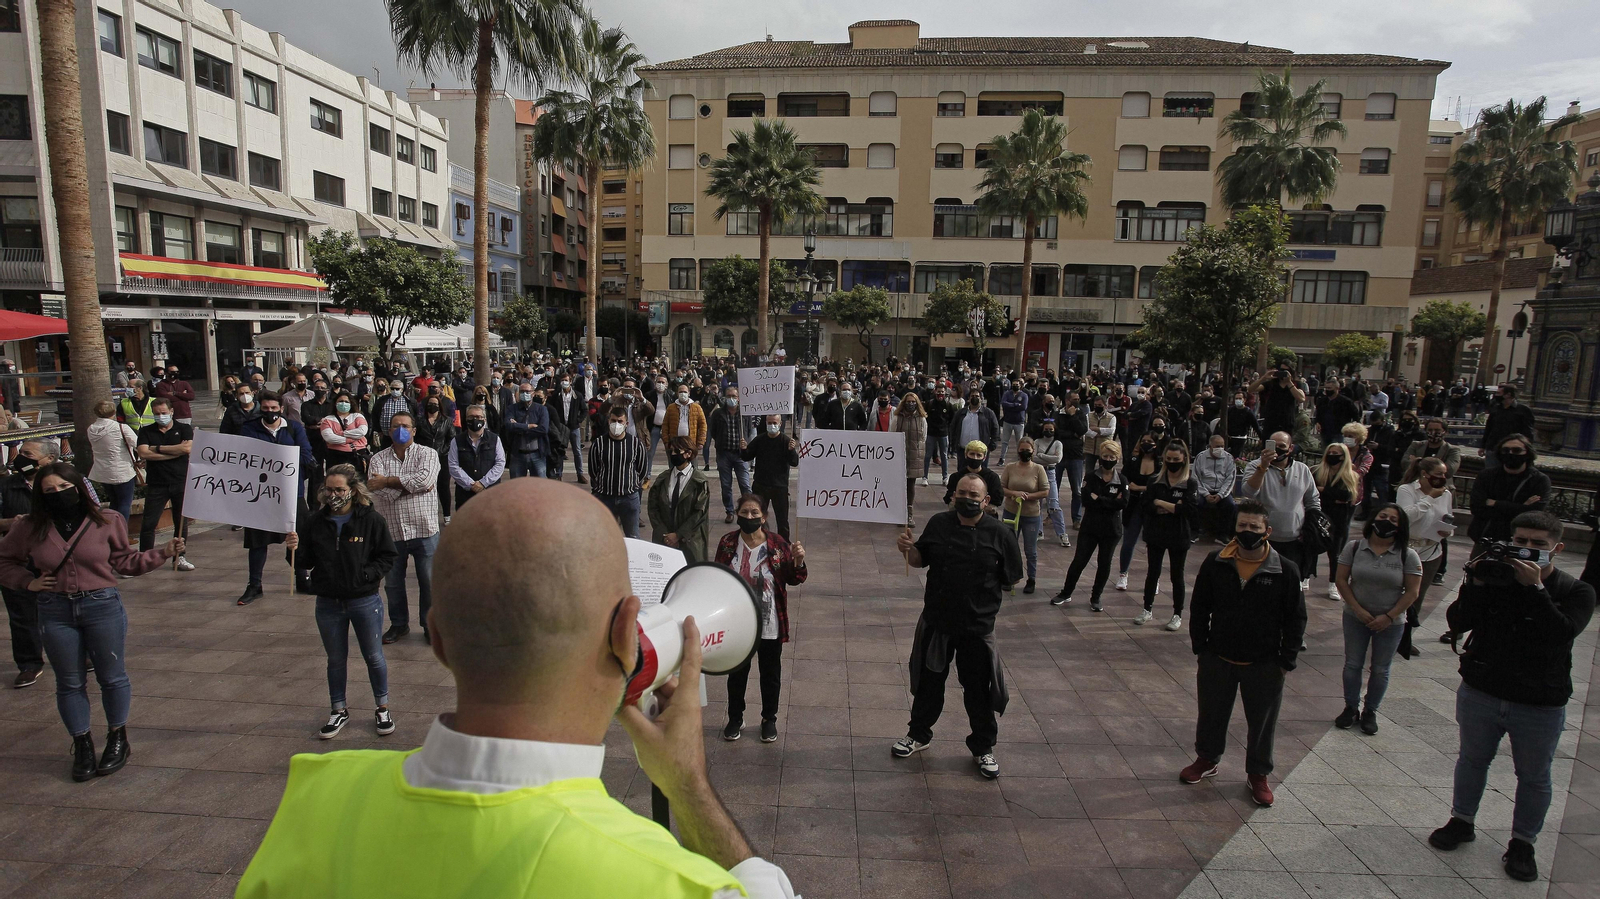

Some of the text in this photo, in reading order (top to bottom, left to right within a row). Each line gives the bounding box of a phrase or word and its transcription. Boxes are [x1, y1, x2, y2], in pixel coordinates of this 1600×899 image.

[526, 214, 535, 267] CENTRO
[754, 368, 779, 380] SOLO
[742, 382, 790, 397] QUEREMOS
[742, 401, 790, 412] TRABAJAR
[201, 446, 296, 477] QUEREMOS
[841, 464, 863, 480] LA
[701, 630, 725, 648] YLE
